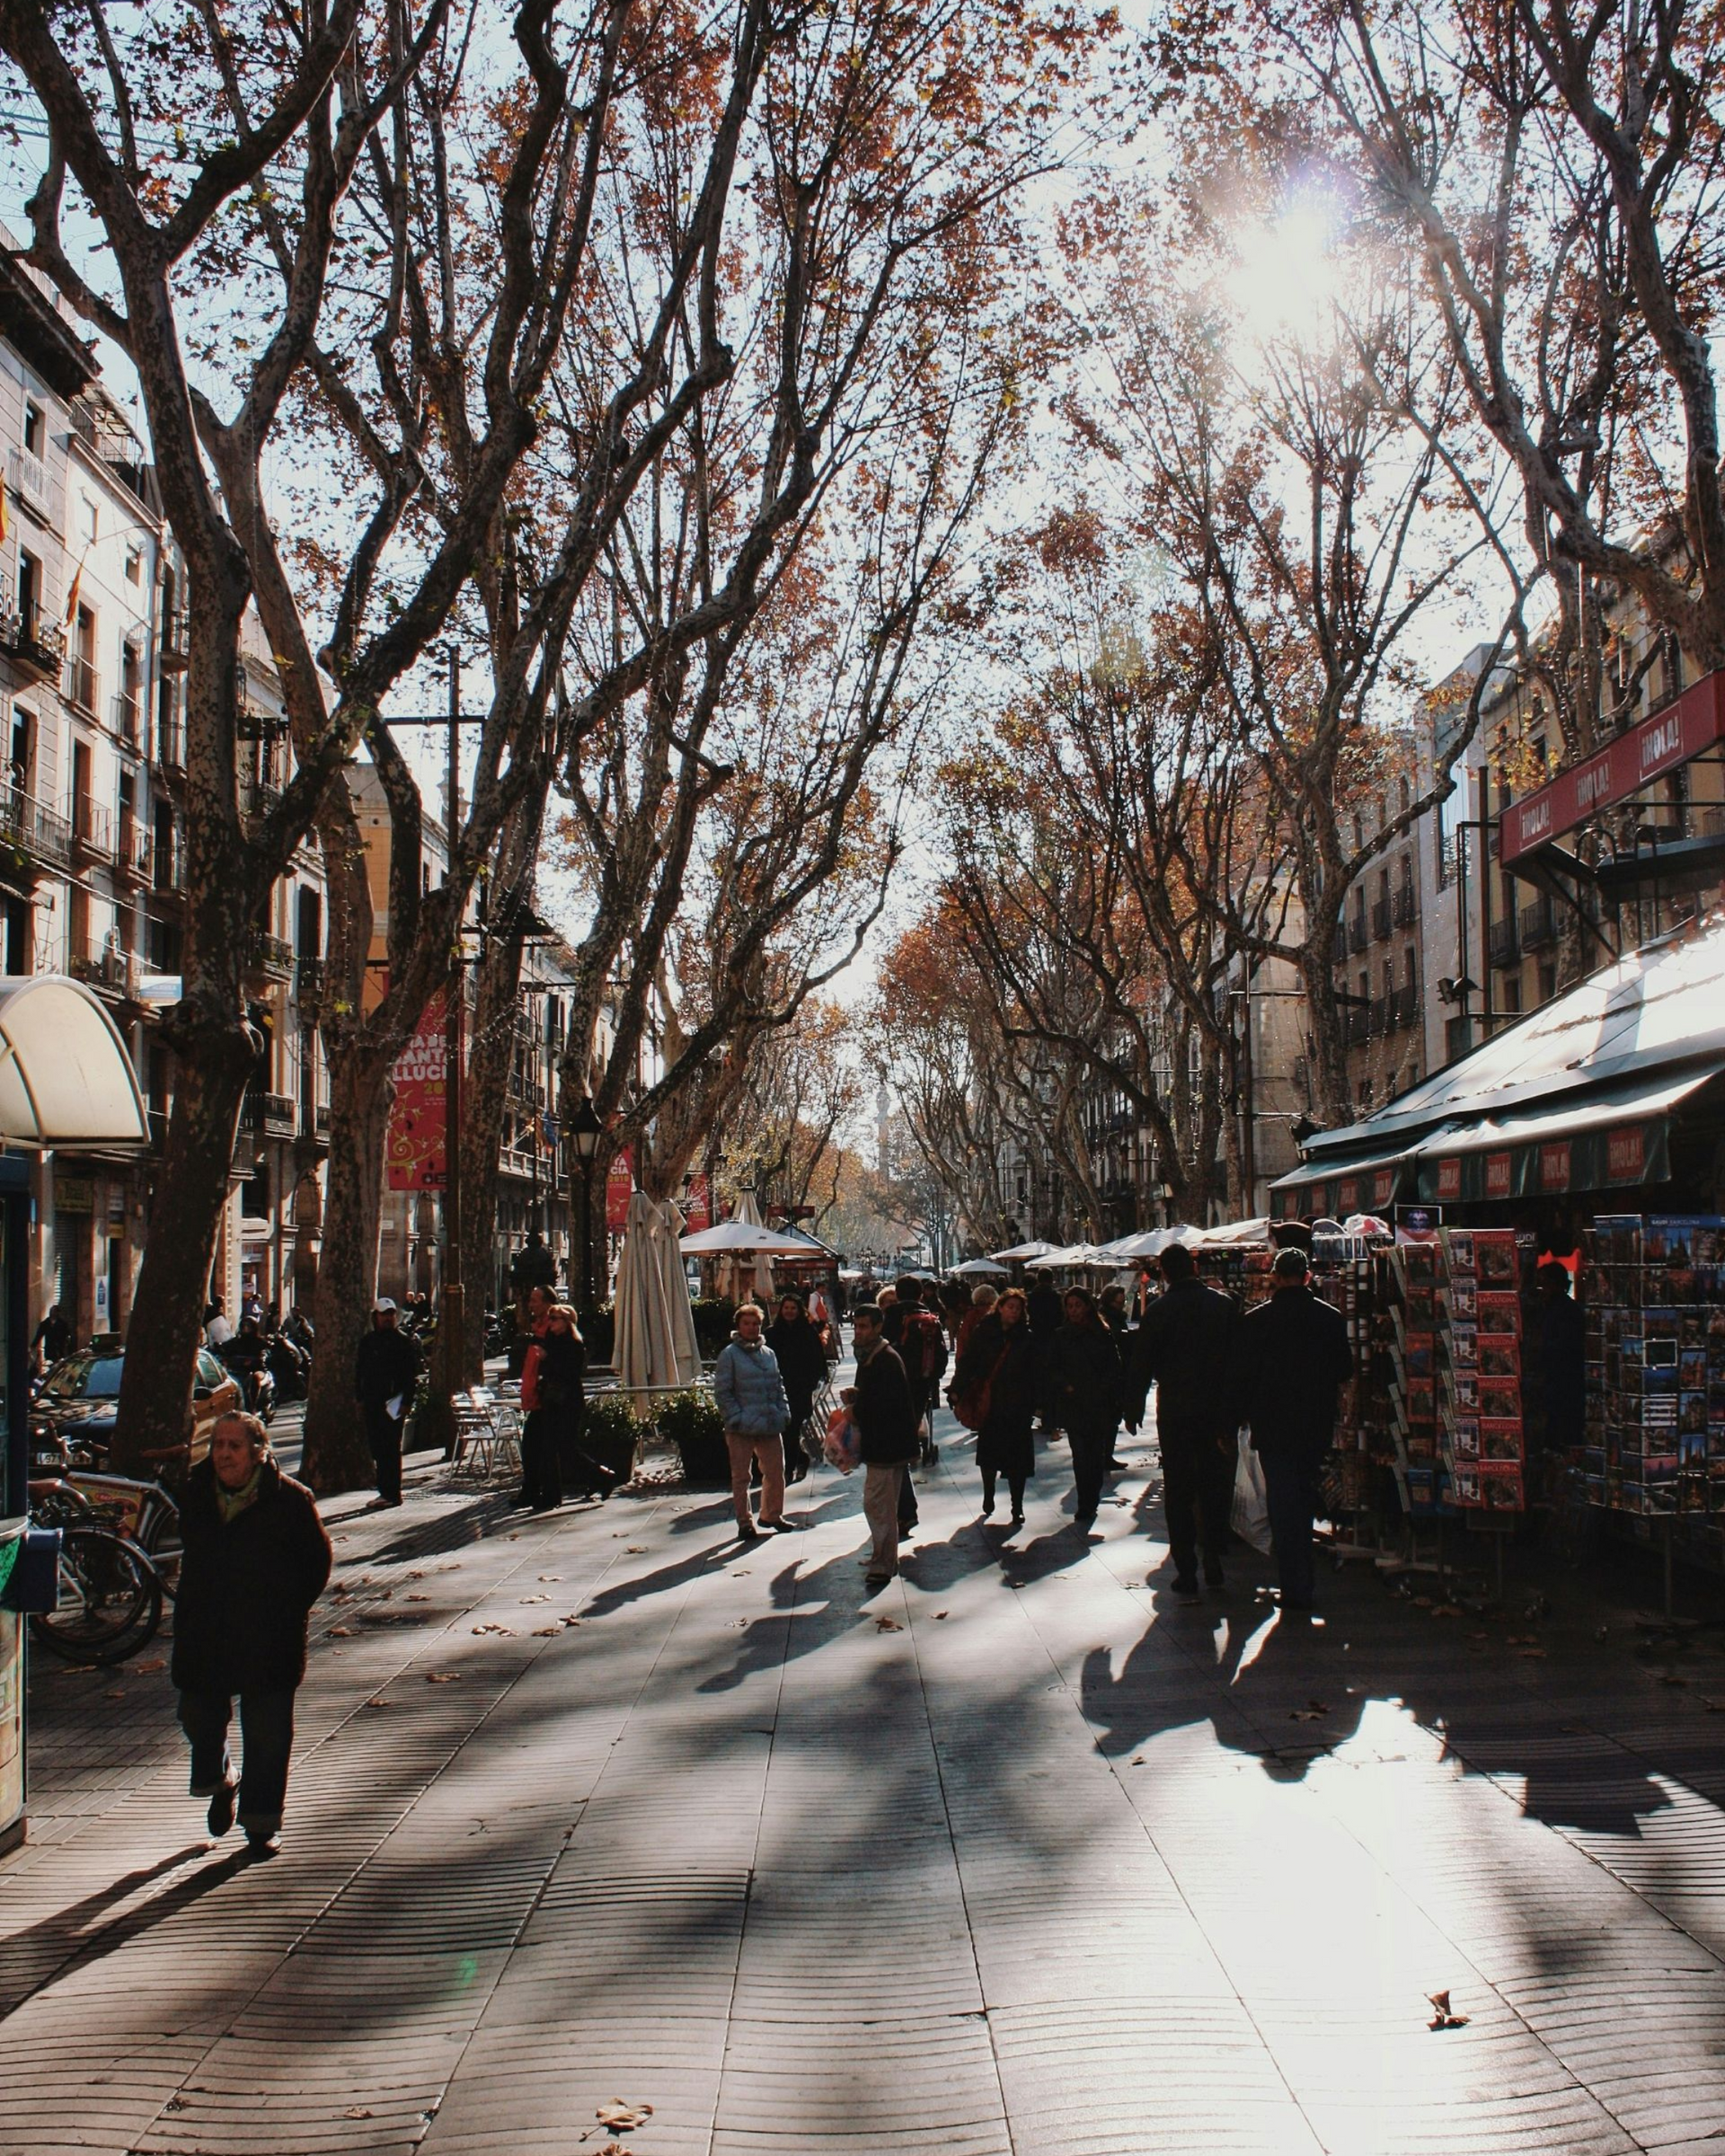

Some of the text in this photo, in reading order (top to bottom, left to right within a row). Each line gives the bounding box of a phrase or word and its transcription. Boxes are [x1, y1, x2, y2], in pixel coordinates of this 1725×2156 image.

[1641, 716, 1679, 768] ¡HOLA!
[1577, 763, 1609, 808] ¡HOLA!
[1522, 800, 1550, 840] ¡HOLA!
